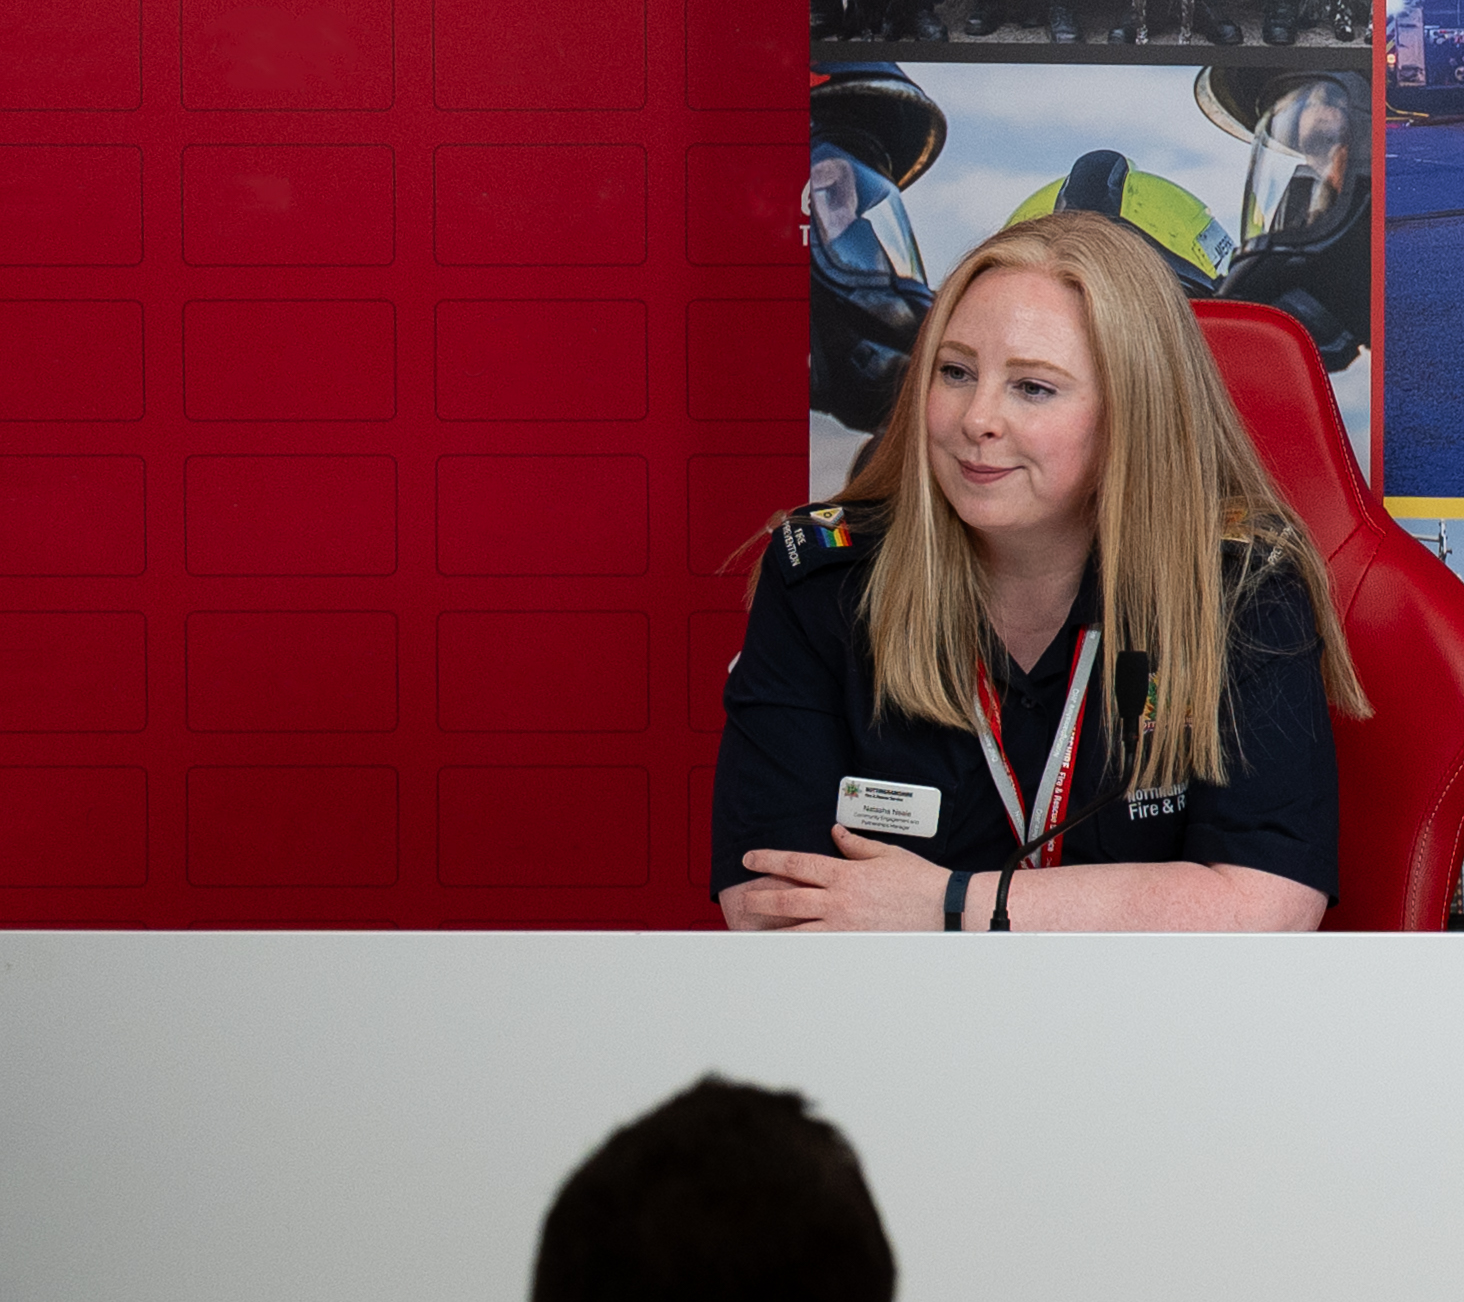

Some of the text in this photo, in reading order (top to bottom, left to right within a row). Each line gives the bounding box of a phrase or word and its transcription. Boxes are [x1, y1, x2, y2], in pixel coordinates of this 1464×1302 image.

[782, 521, 800, 567] PREVENTION
[794, 528, 807, 546] FIRE
[1128, 800, 1160, 821] Fire
[1162, 799, 1175, 814] &
